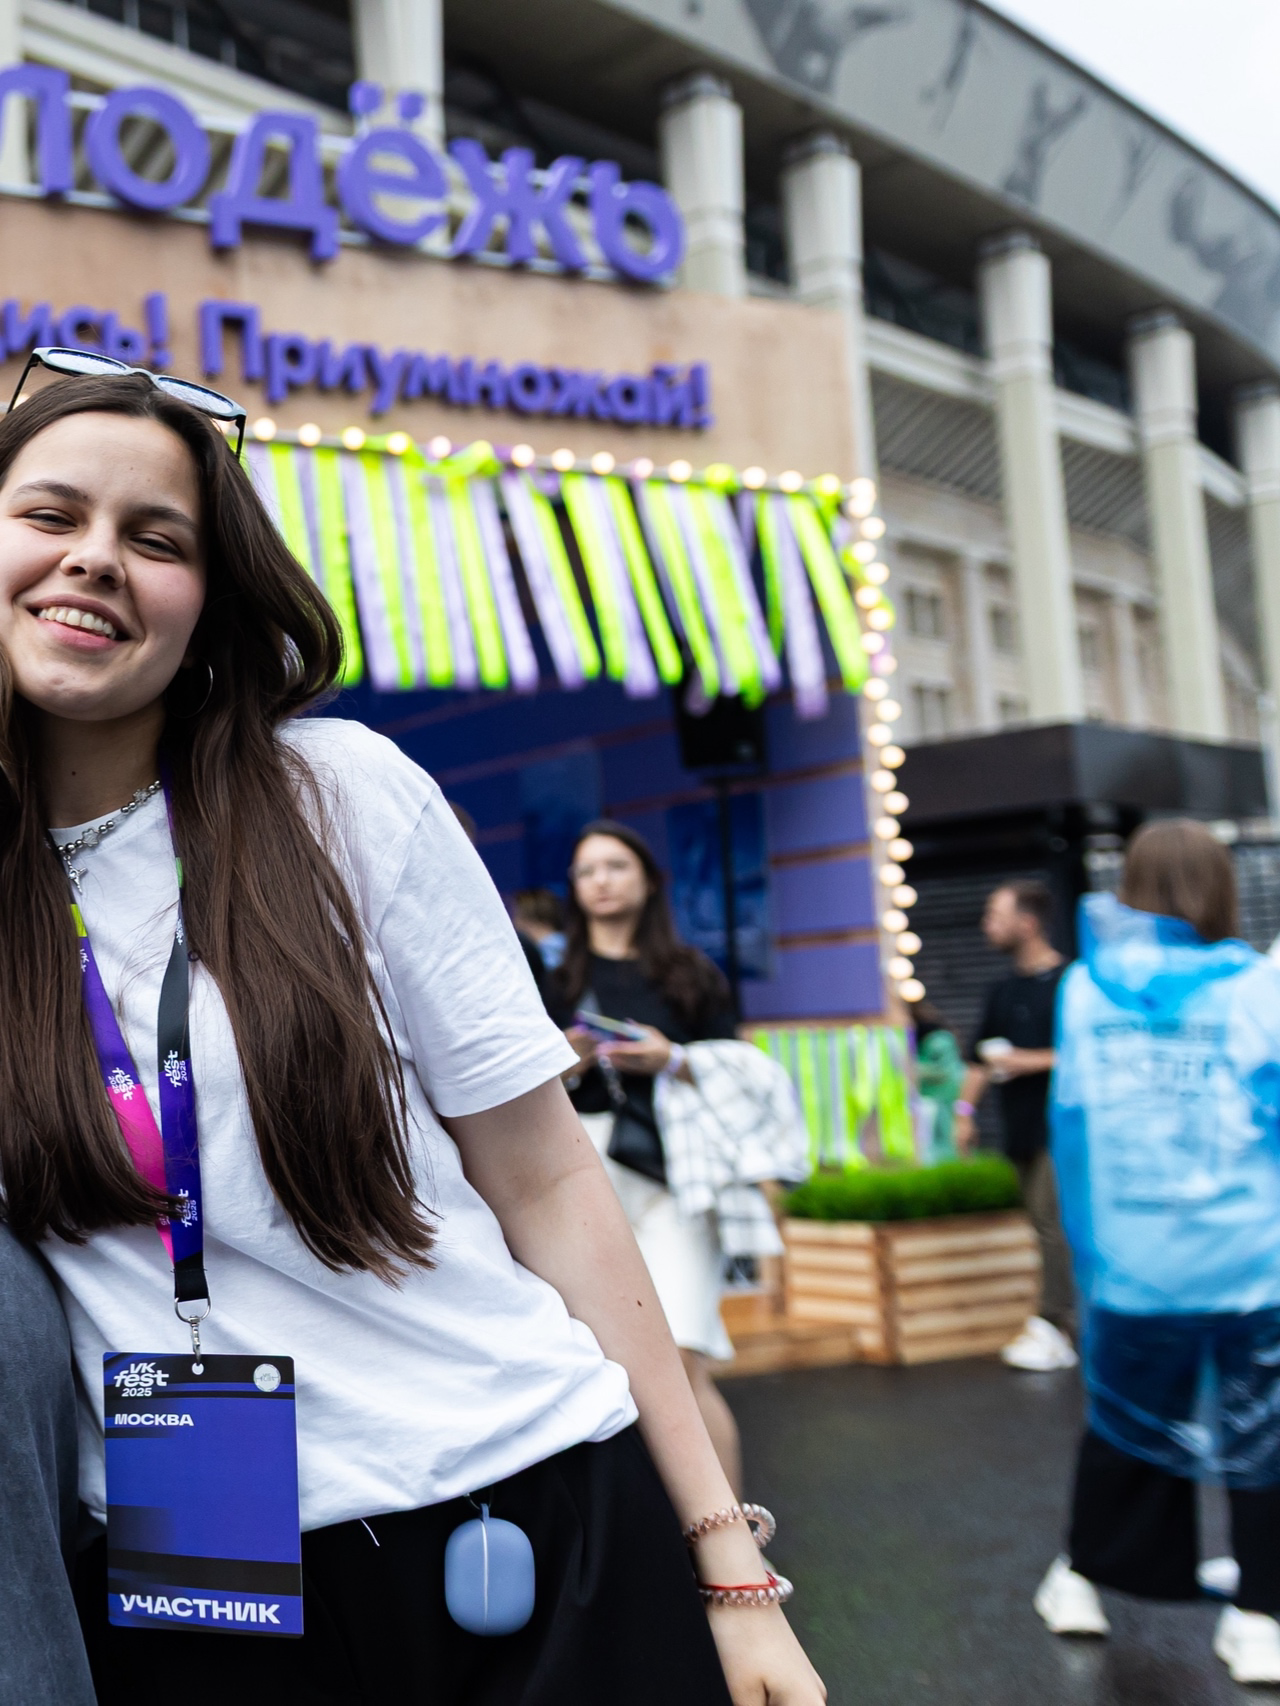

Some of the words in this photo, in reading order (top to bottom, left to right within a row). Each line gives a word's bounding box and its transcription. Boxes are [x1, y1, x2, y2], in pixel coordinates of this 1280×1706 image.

[202, 302, 713, 428] Приумножай!
[163, 1060, 172, 1077] VK
[168, 1050, 182, 1088] fest
[112, 1067, 133, 1100] fest
[130, 1362, 156, 1374] VK
[113, 1370, 170, 1387] fest
[121, 1387, 152, 1397] 2025
[114, 1413, 194, 1427] МОСКВА
[120, 1594, 281, 1624] УЧАСТНИК
